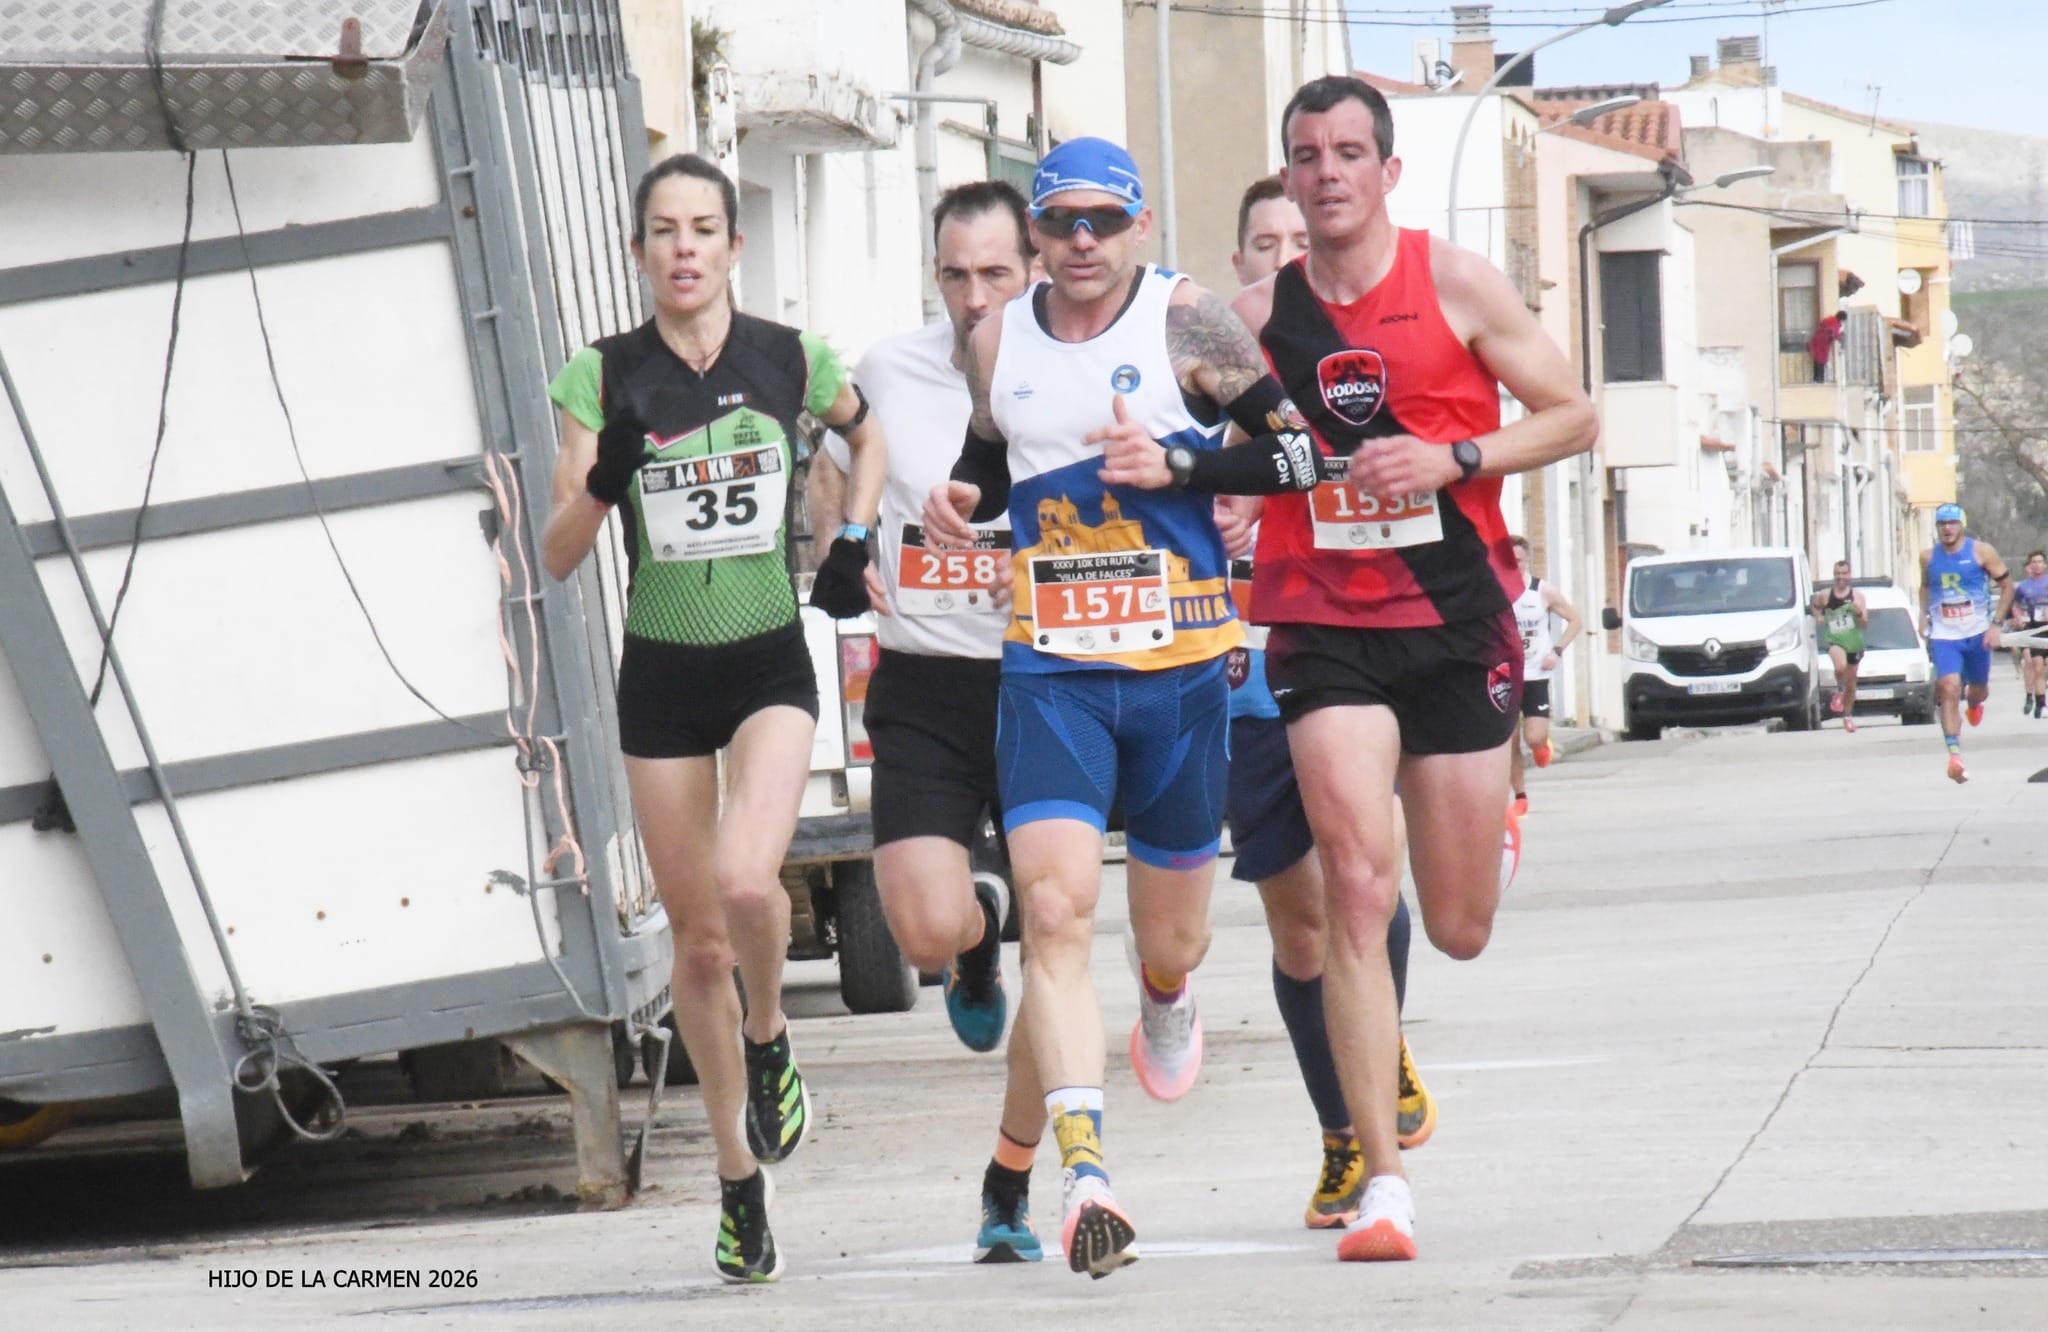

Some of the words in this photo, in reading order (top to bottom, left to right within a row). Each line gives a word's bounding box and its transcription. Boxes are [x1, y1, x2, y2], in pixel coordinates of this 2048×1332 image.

[1326, 381, 1380, 399] LODOSA
[685, 482, 758, 531] 35
[920, 554, 996, 584] 258
[1052, 561, 1075, 569] XXXV
[1077, 560, 1094, 568] 10K
[1096, 558, 1108, 567] EN
[1110, 556, 1135, 565] RUTA
[1056, 572, 1083, 582] "VILLA
[1085, 571, 1097, 580] DE
[1101, 569, 1135, 579] FALCES"
[1061, 585, 1133, 621] 157
